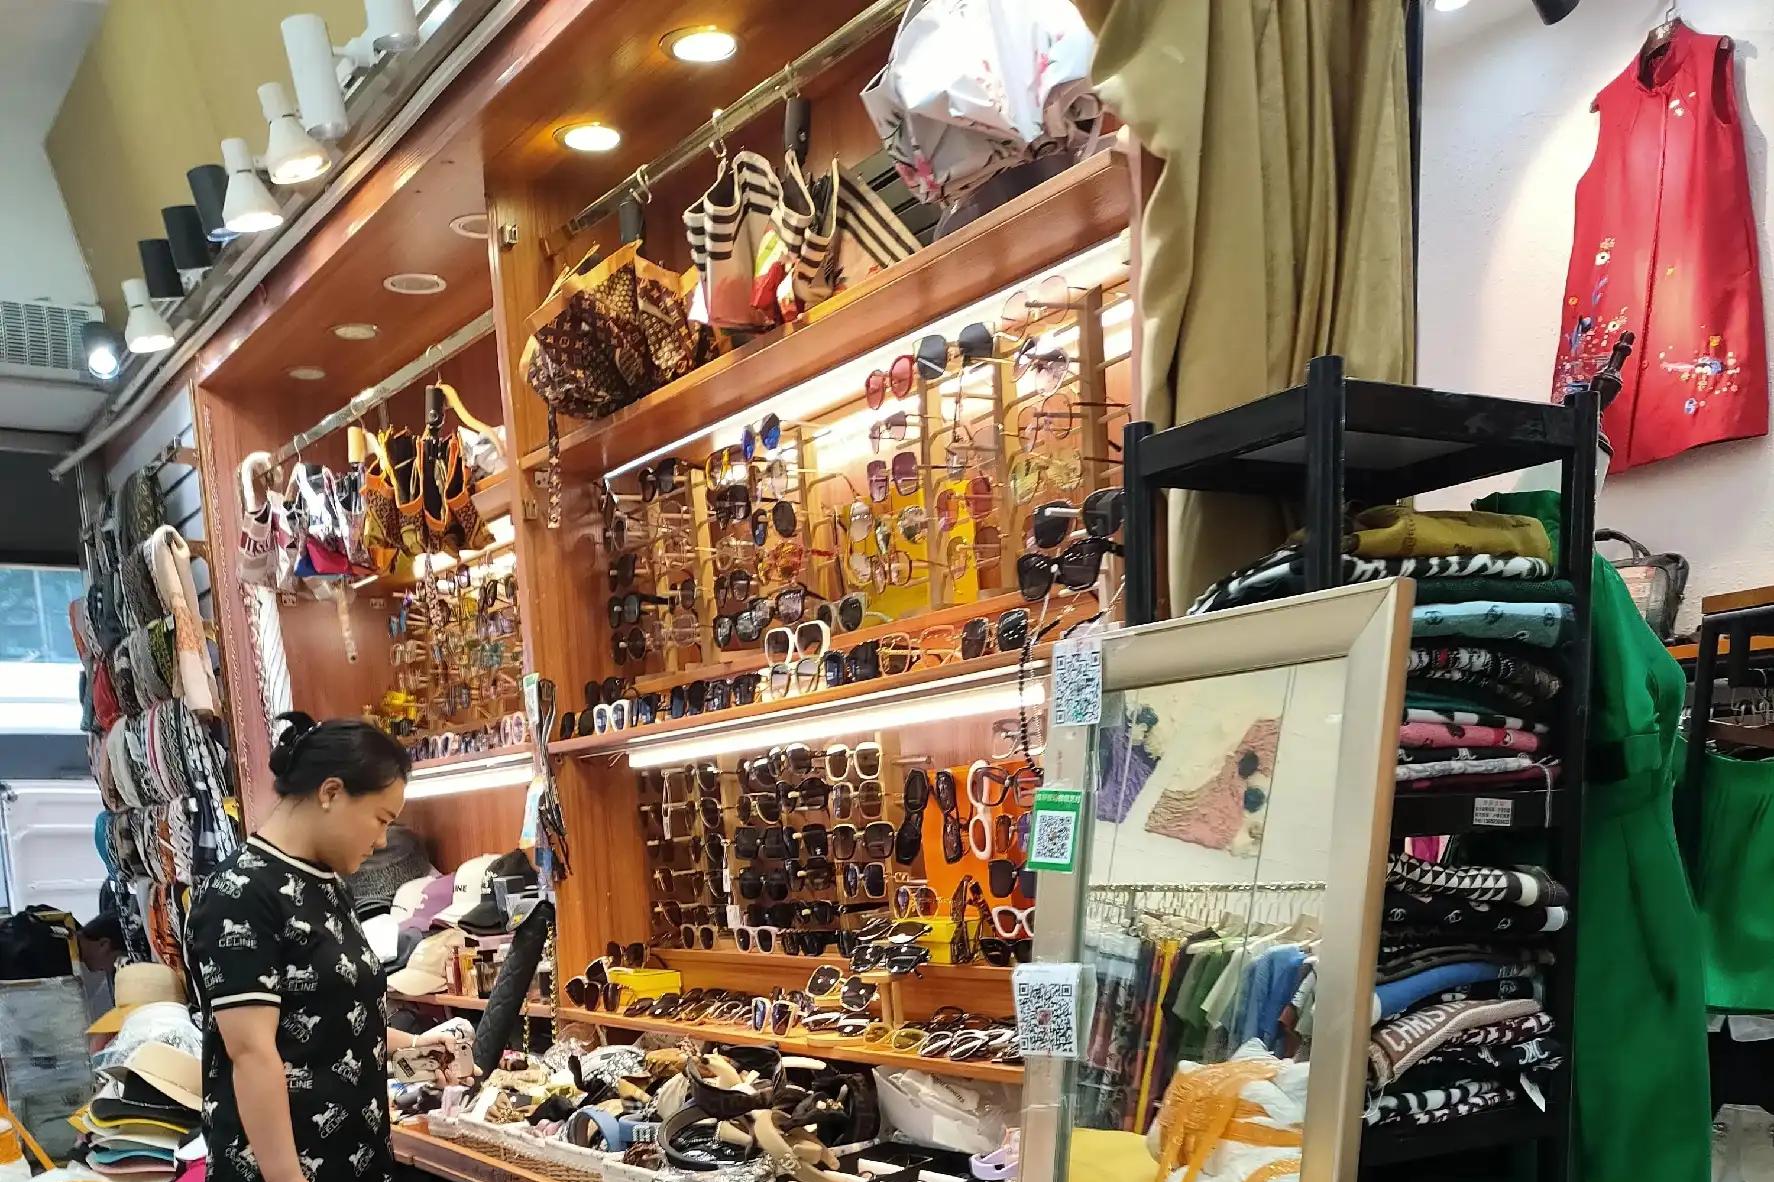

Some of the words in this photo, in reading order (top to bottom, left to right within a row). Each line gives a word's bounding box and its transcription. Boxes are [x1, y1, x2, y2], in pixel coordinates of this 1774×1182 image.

[218, 937, 258, 949] CELINE
[281, 981, 319, 992] ELINE
[287, 1079, 313, 1090] LINE
